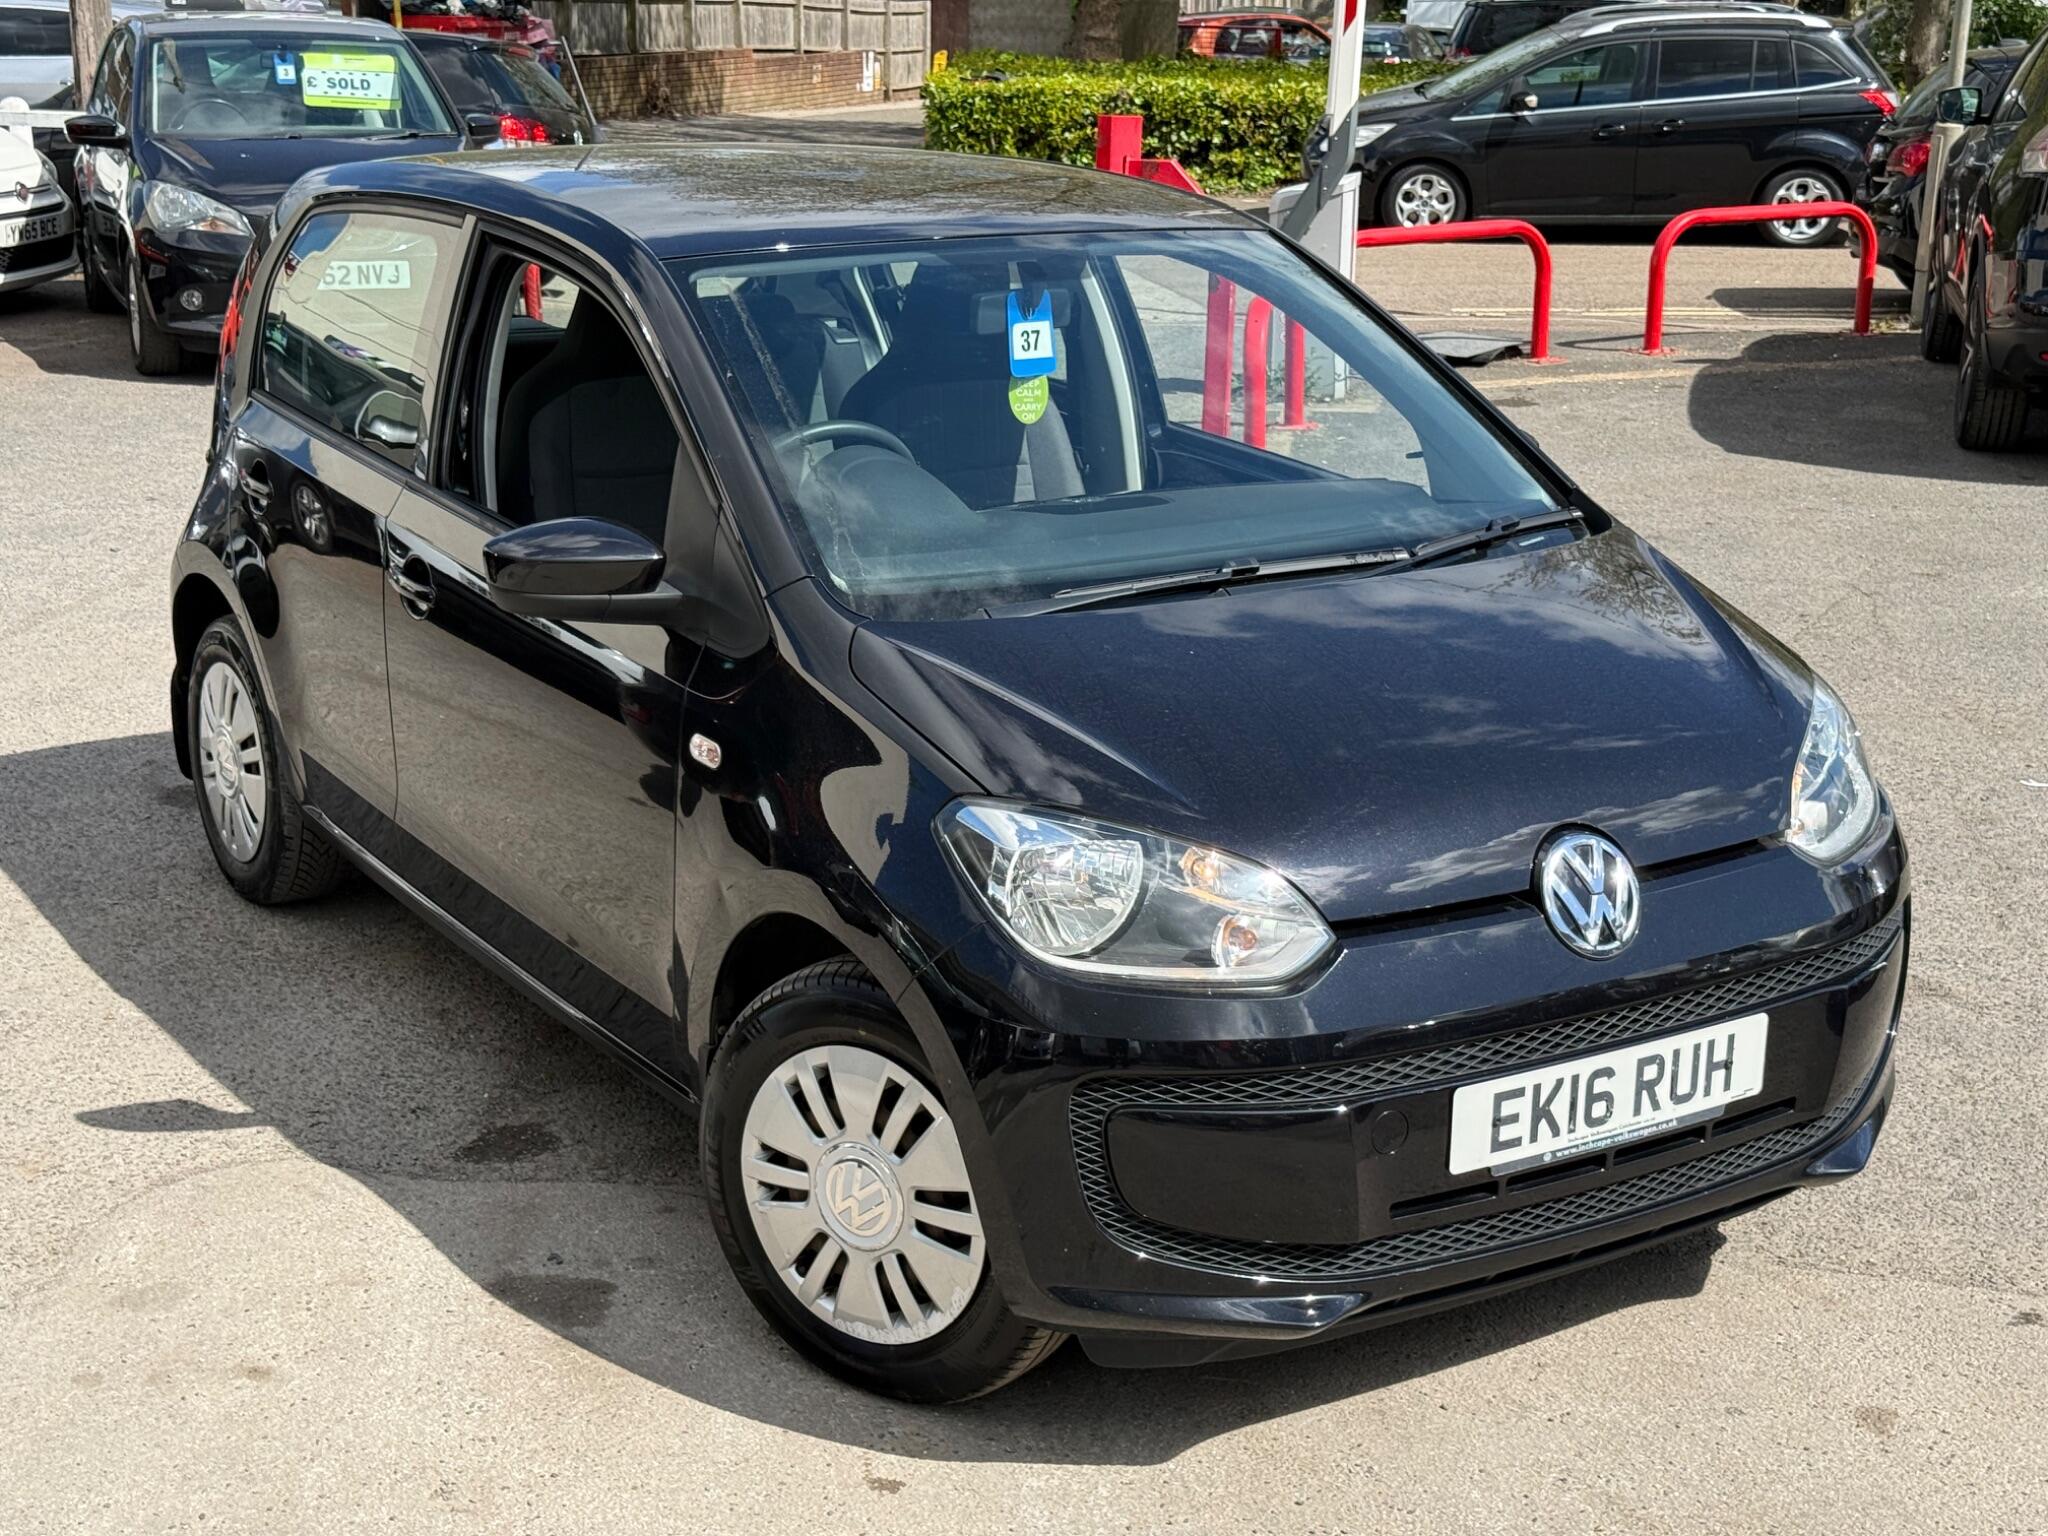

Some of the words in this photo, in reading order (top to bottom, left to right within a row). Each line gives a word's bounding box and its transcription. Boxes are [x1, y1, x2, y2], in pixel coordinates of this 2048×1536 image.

[306, 76, 318, 88] £
[327, 77, 371, 91] SOLD
[357, 264, 400, 285] NVJ
[1020, 329, 1041, 352] 37
[1016, 389, 1042, 397] CALM
[1014, 402, 1042, 411] CARRY
[1021, 412, 1036, 420] ON
[1490, 1066, 1616, 1154] EK16
[1632, 1033, 1735, 1117] RUH
